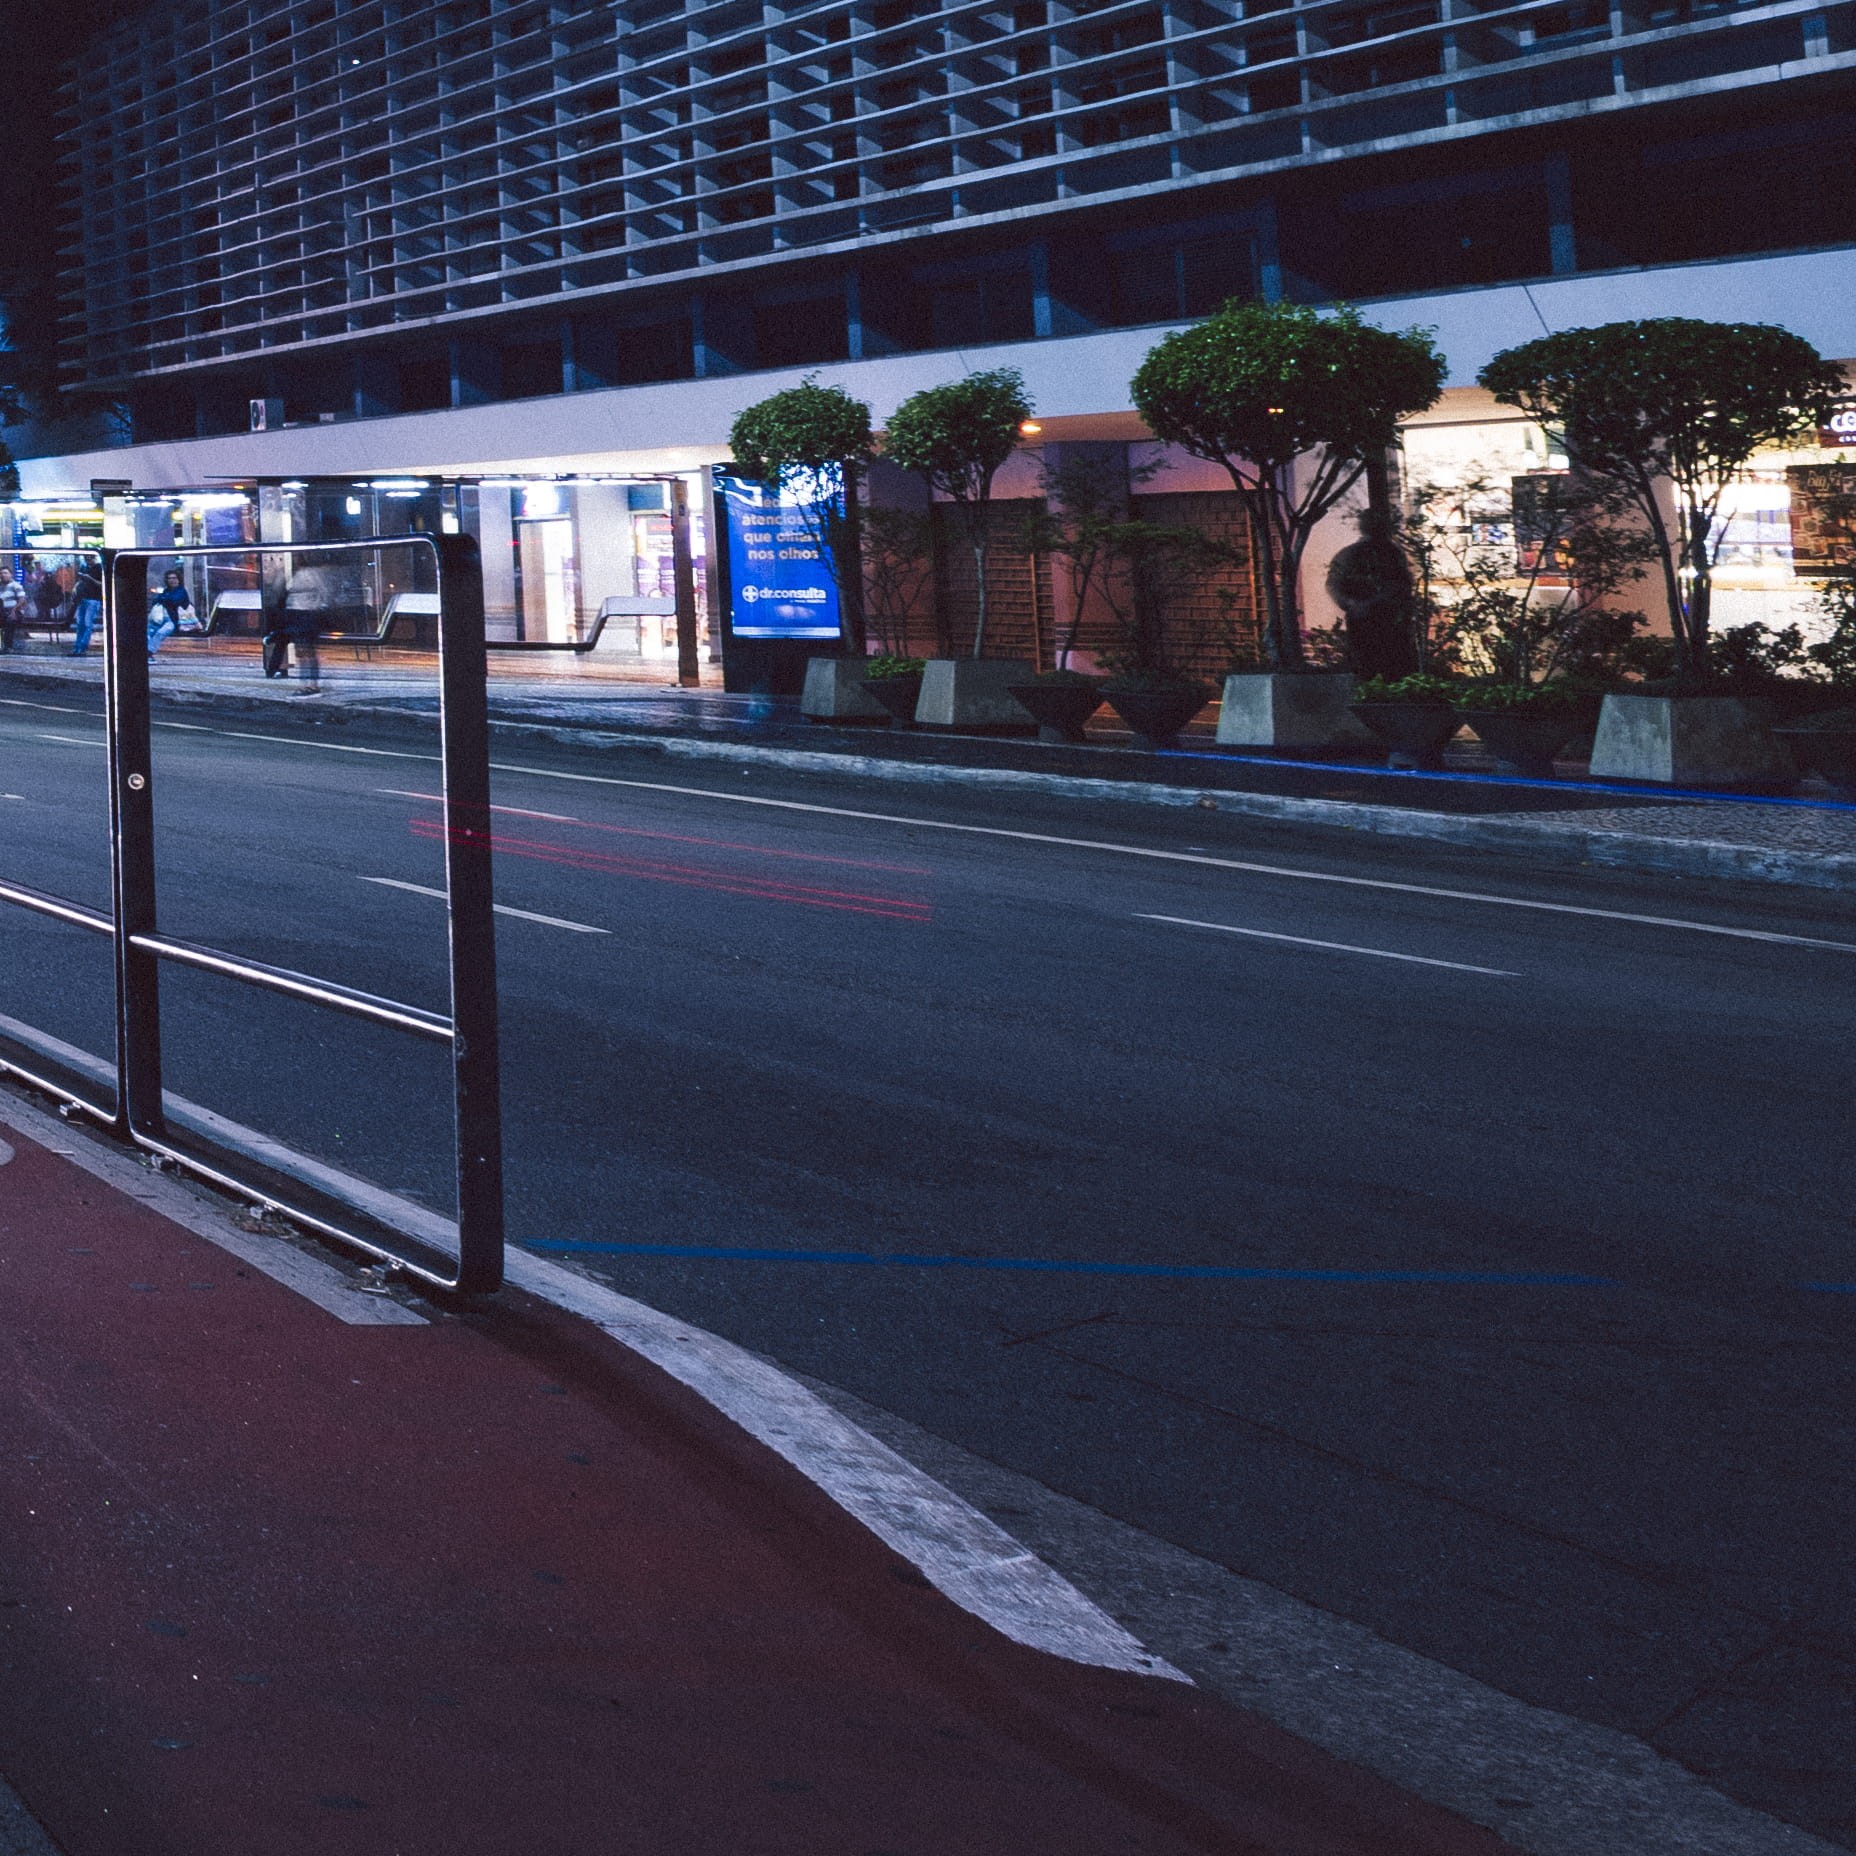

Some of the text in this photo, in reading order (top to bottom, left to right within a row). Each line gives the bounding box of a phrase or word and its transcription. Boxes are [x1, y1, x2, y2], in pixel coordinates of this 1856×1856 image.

[744, 532, 772, 545] que
[748, 546, 819, 560] nos olhos
[759, 587, 826, 599] dr.consulta
